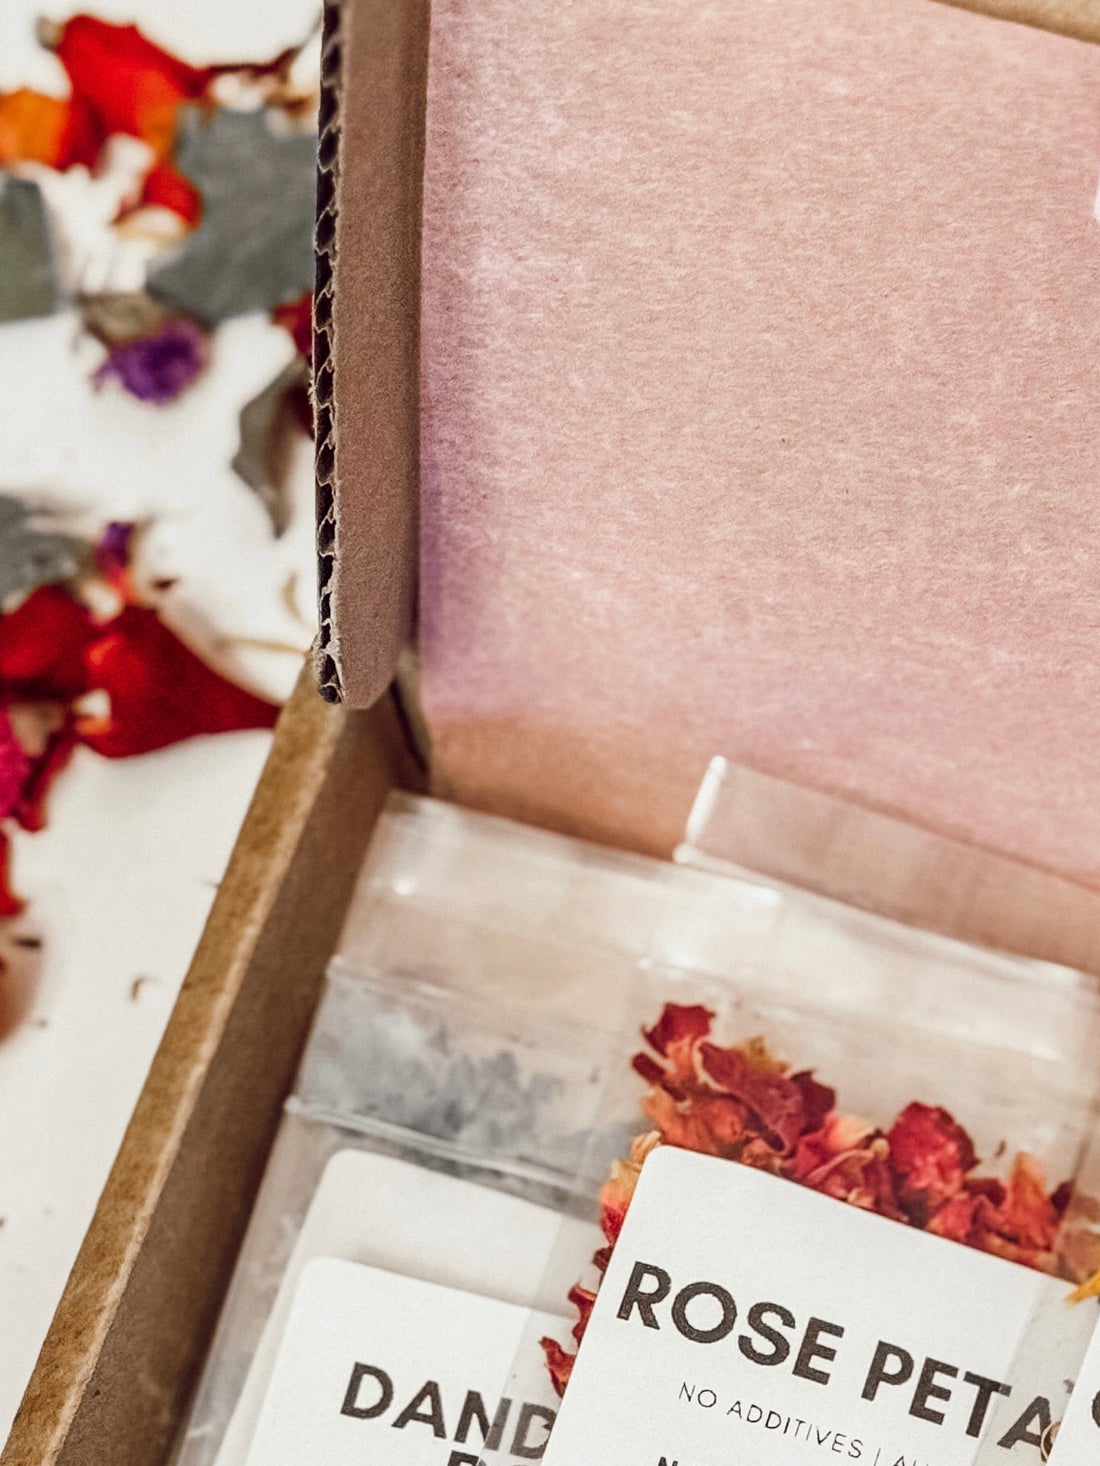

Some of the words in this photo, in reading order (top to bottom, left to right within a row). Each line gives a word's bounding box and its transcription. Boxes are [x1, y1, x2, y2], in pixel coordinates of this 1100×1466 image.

[616, 1261, 845, 1385] ROSE
[677, 1381, 718, 1408] NO
[726, 1400, 863, 1459] ADDITIVES
